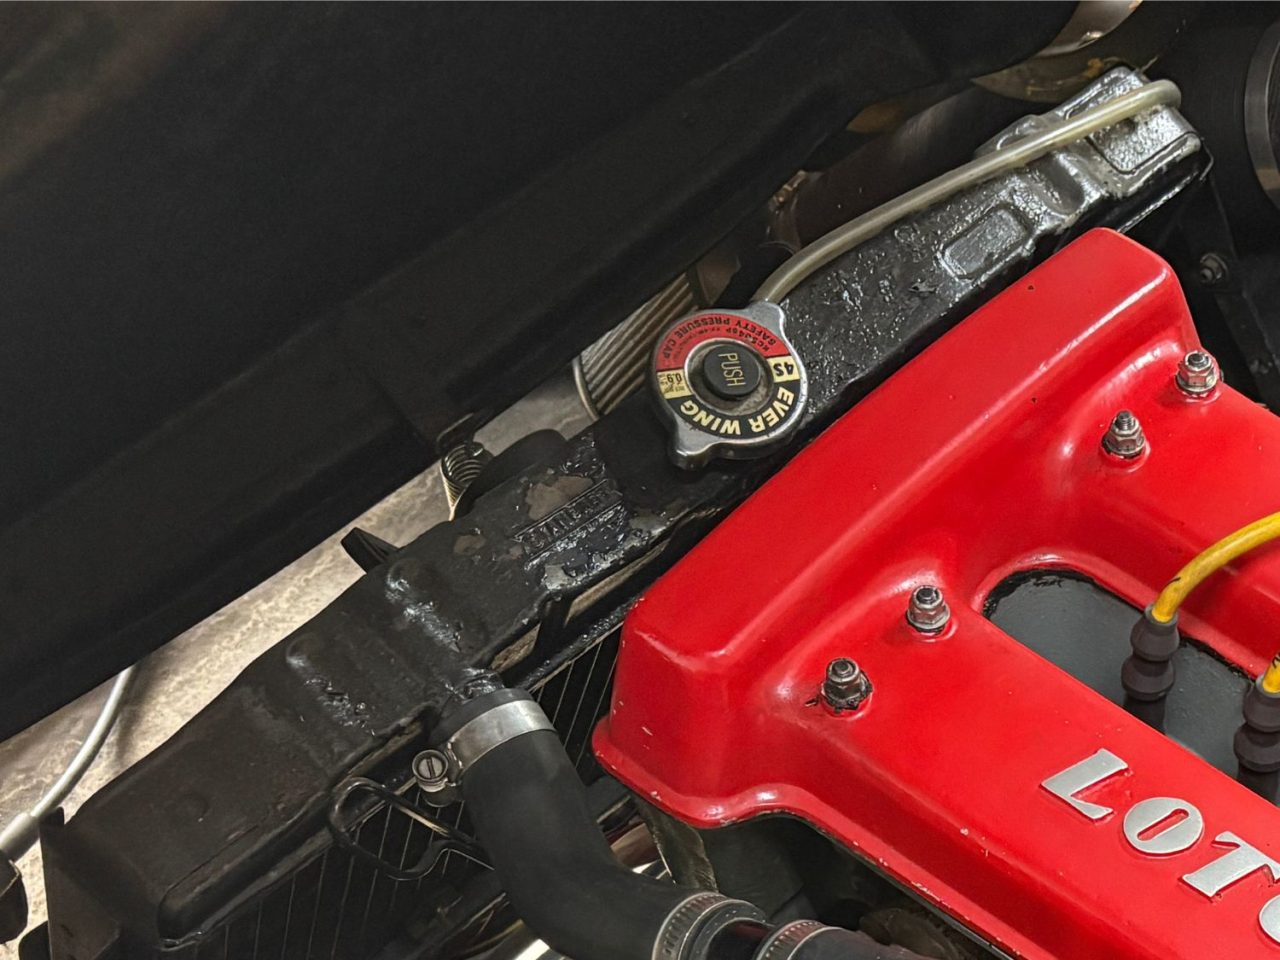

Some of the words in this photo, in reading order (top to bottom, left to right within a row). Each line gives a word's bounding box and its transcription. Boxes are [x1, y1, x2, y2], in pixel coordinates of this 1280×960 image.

[674, 316, 731, 339] PRESSURE
[736, 320, 777, 346] SAFETY
[662, 338, 678, 360] CAP
[666, 372, 682, 384] 0.9
[718, 352, 746, 387] PUSH
[772, 362, 794, 377] 4S
[680, 399, 742, 436] WING
[747, 386, 795, 434] EVER
